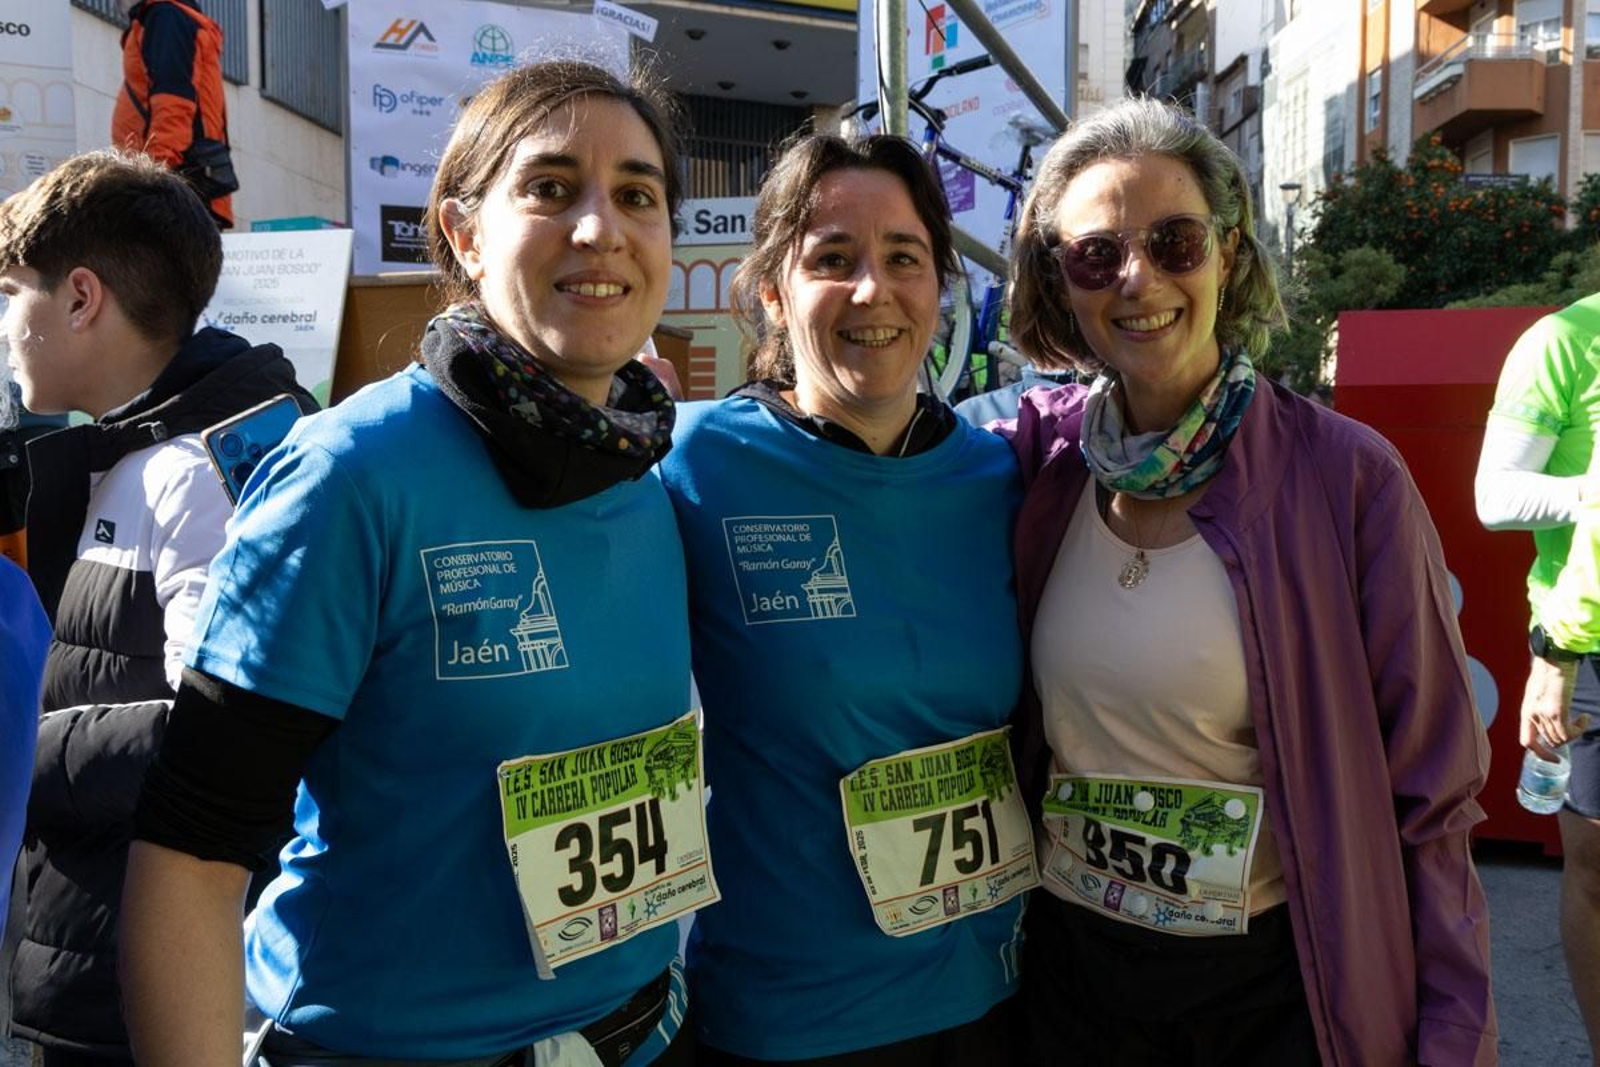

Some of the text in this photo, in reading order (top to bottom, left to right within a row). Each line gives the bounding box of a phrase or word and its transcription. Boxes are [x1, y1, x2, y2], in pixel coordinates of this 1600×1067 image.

[694, 209, 746, 235] San
[221, 266, 242, 277] AN
[223, 309, 317, 325] daño cerebral
[733, 523, 810, 534] CONSERVATORIO
[735, 533, 812, 544] PROFESIONAL DE
[434, 550, 513, 569] CONSERVATORIO
[436, 562, 517, 582] PROFESIONAL DE
[439, 578, 482, 595] MÚSICA
[751, 590, 799, 613] Jaén
[447, 638, 510, 665] Jaén
[539, 756, 569, 786] SAN
[571, 746, 606, 777] JUAN
[610, 738, 646, 765] BOSCO
[885, 761, 914, 786] SAN
[920, 752, 952, 780] JUAN
[516, 763, 638, 820] IV CARRERA POPULAR
[863, 792, 875, 812] IV
[880, 782, 935, 811] CARRERA
[1094, 783, 1135, 805] JUAN
[554, 798, 668, 908] 354
[912, 798, 1000, 888] 751
[1168, 907, 1192, 921] daño
